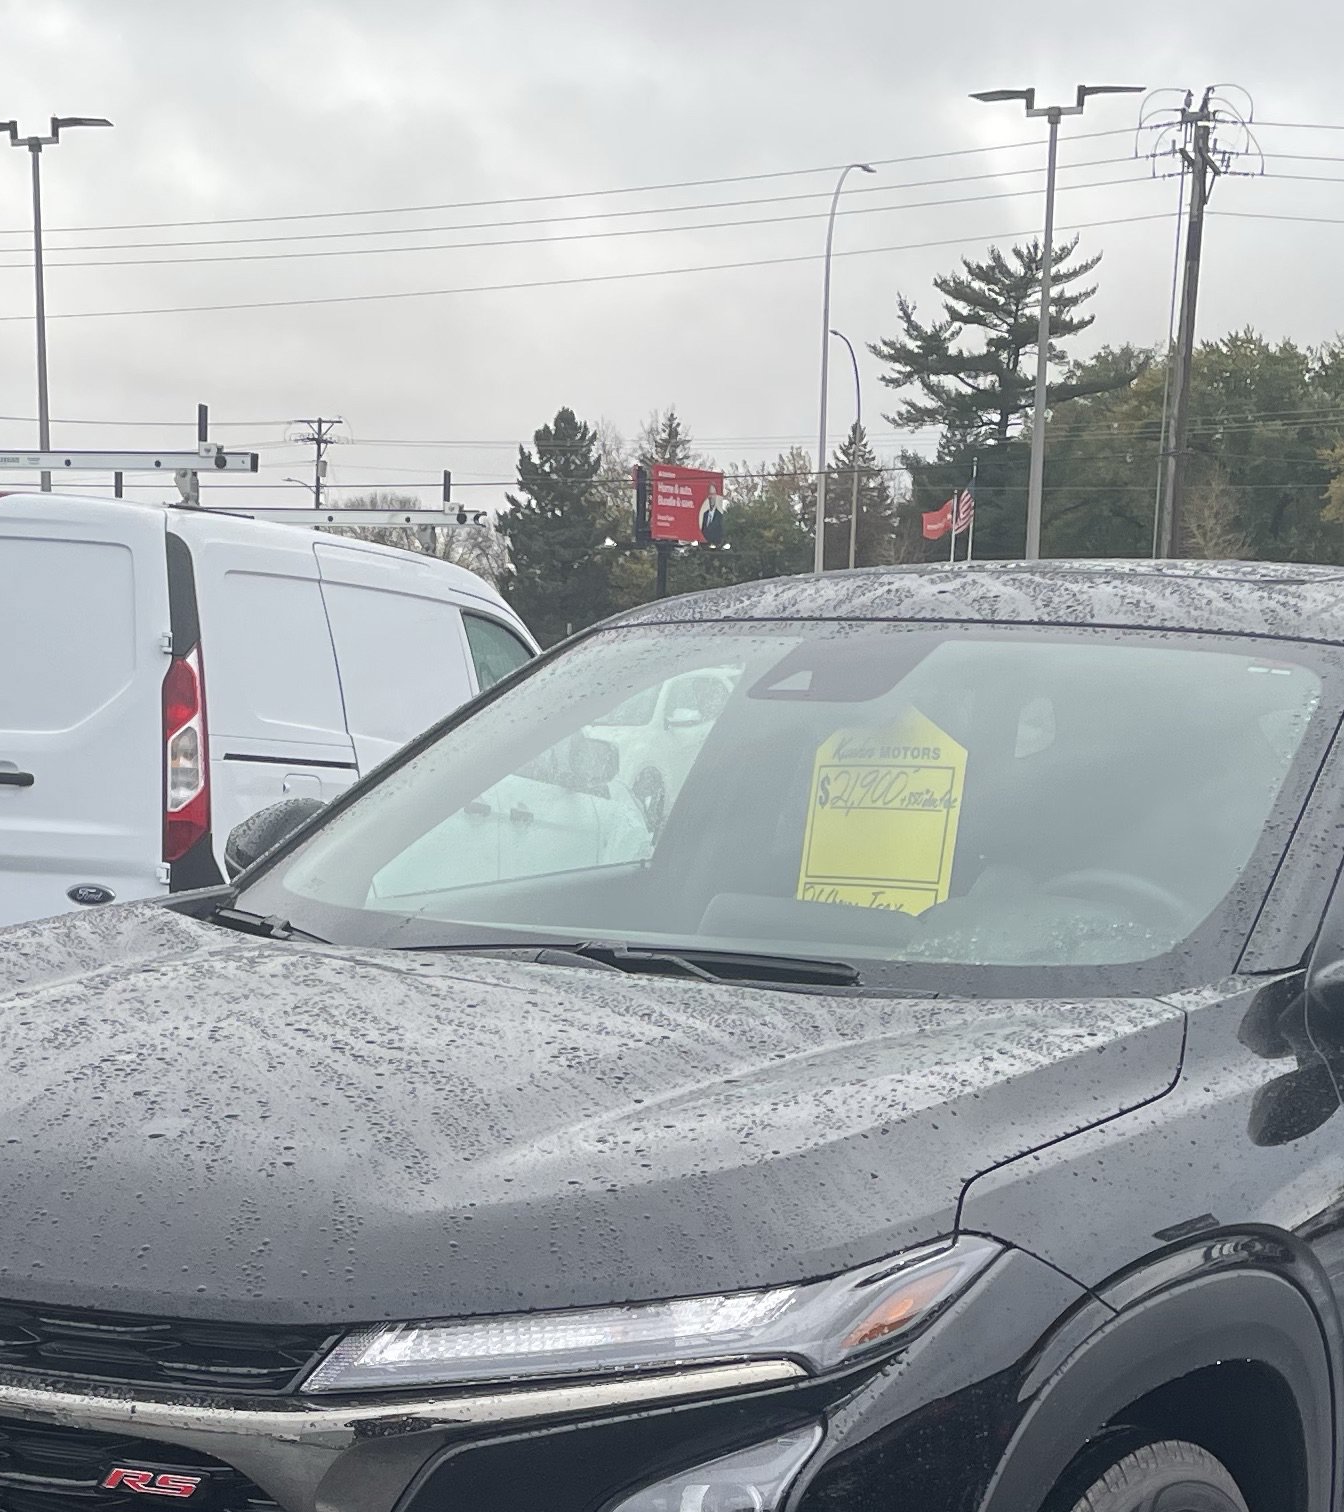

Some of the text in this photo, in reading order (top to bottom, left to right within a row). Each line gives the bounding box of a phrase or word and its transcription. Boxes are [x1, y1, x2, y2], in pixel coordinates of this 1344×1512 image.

[879, 745, 941, 761] MOTORS
[76, 887, 104, 901] Ford
[102, 1467, 202, 1498] RS
